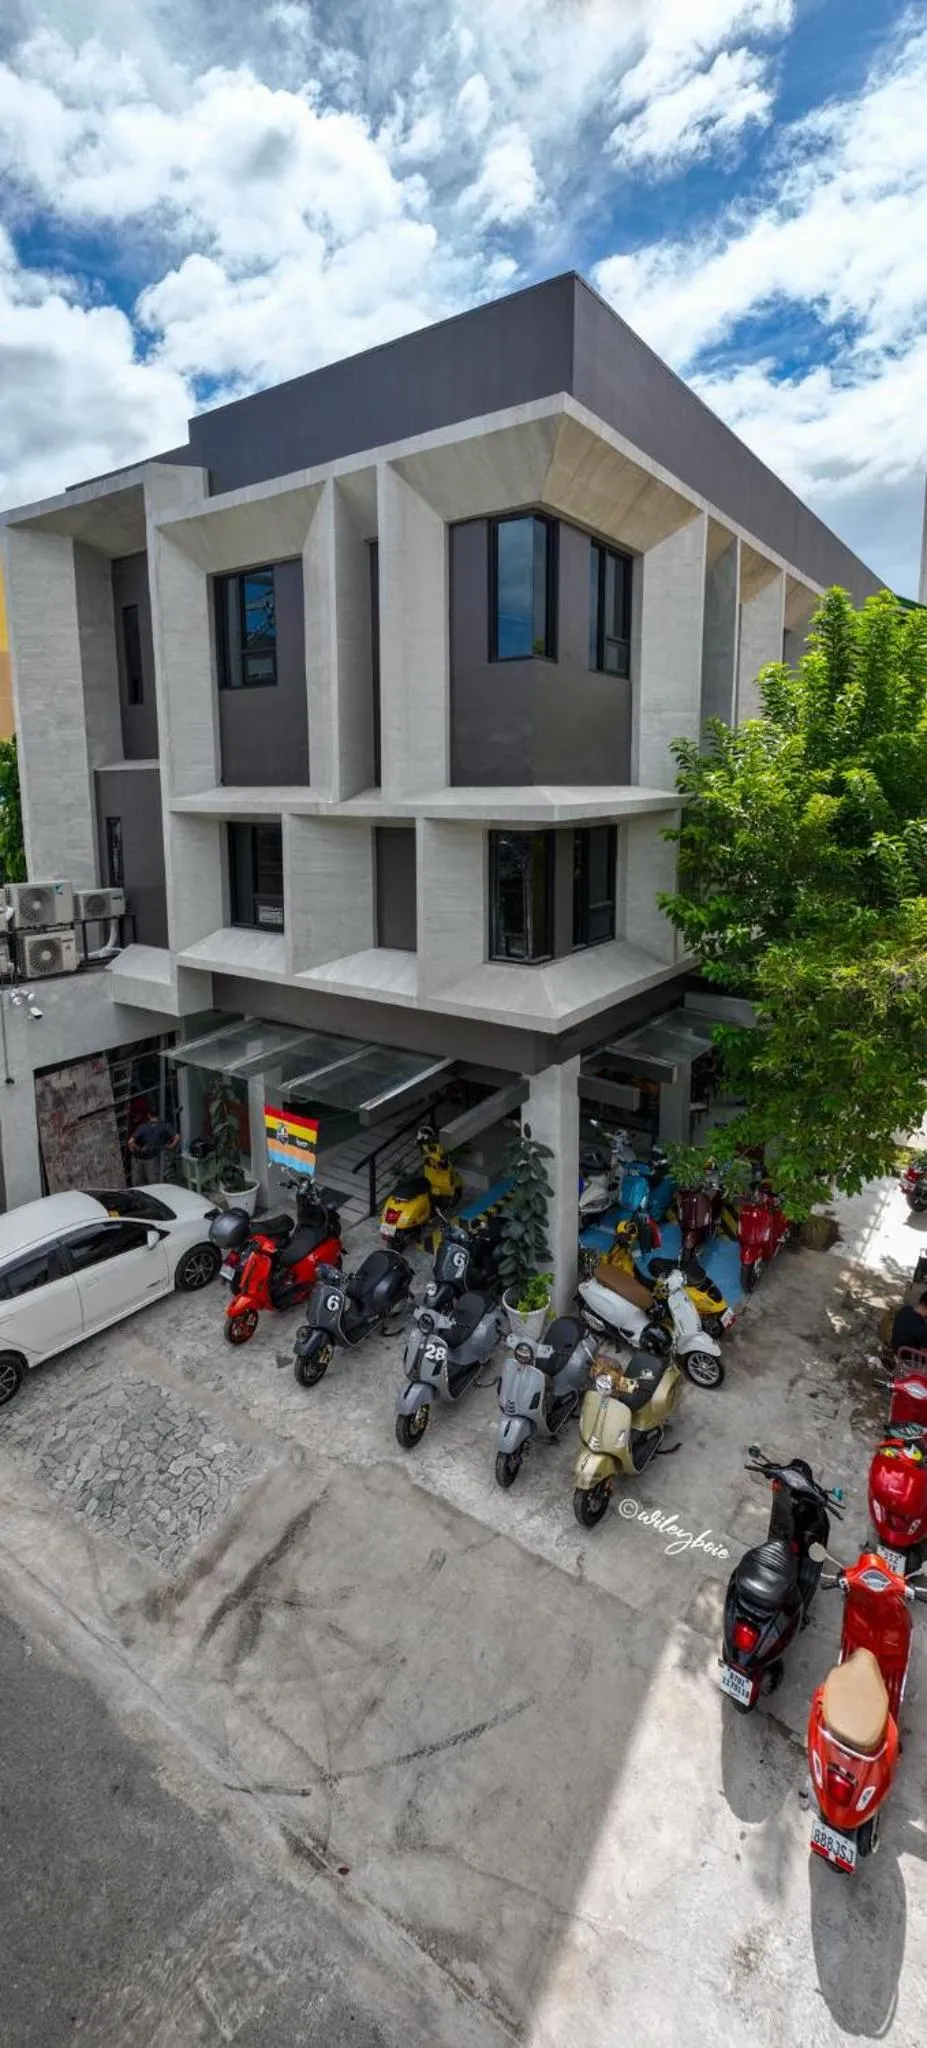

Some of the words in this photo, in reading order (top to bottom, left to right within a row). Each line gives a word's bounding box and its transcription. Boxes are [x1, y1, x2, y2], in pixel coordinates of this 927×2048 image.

[327, 1295, 341, 1311] 6
[424, 1344, 446, 1361] 28
[813, 1829, 855, 1865] 888JSJ
